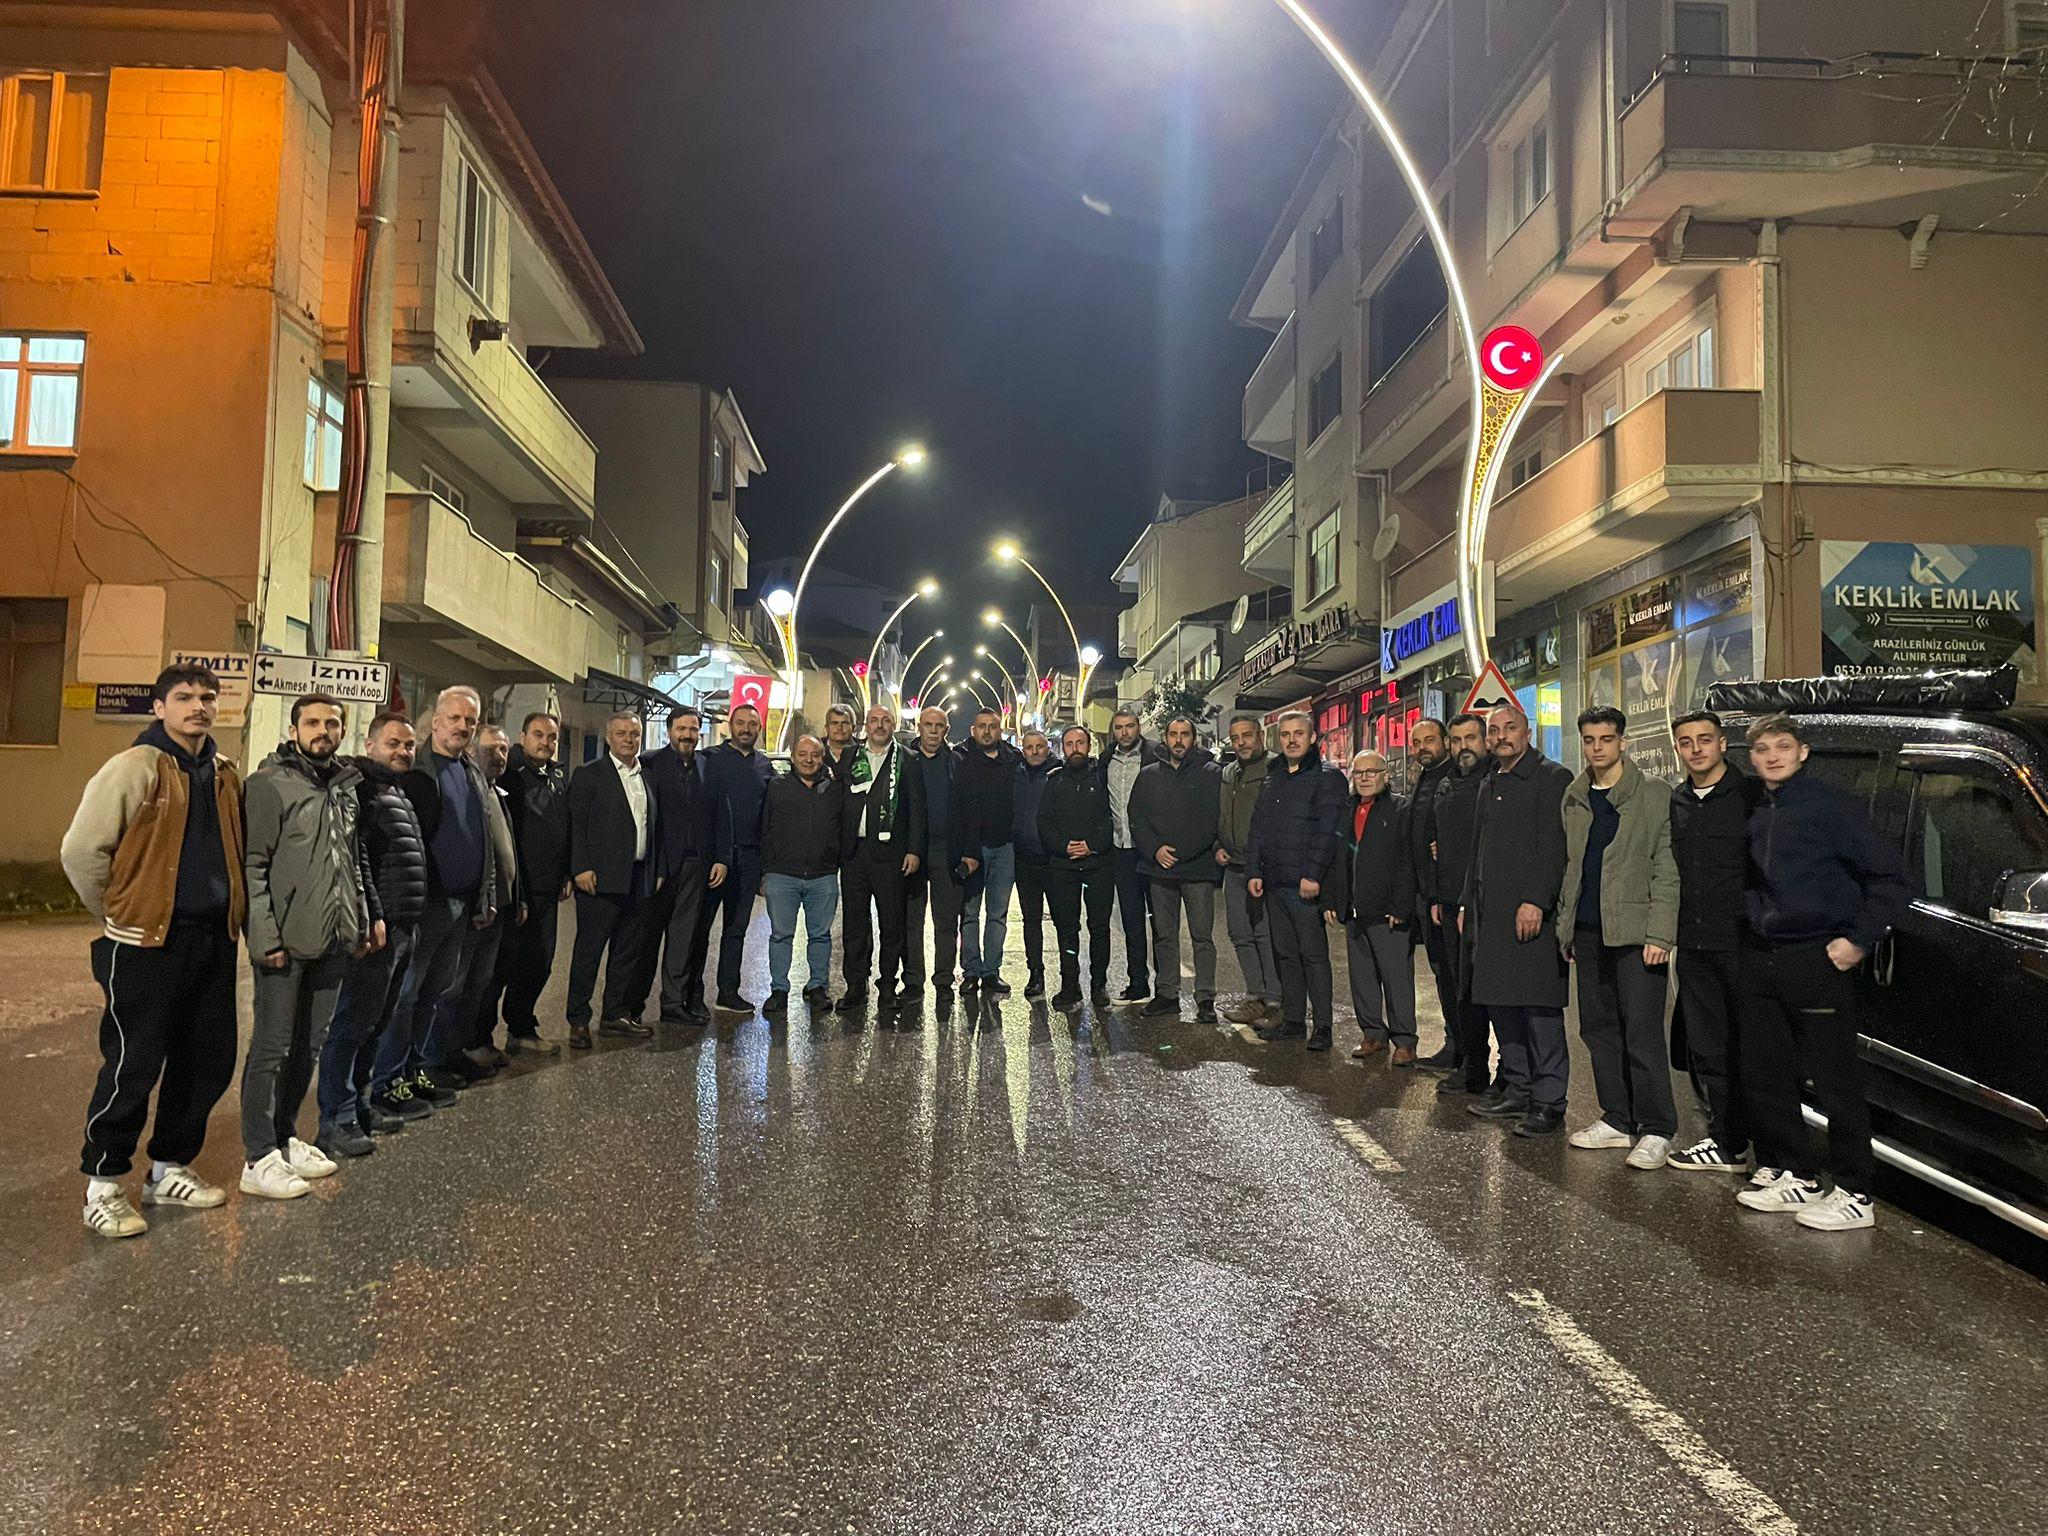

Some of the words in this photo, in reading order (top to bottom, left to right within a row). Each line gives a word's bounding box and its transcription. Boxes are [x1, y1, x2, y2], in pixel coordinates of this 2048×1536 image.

[1653, 600, 1673, 616] EMLAK
[1931, 588, 2021, 611] EMLAK
[1434, 597, 1461, 642] EML
[1873, 639, 1941, 650] ARAZİLERİNİZ
[1944, 639, 1986, 651] GÜNLÜK
[1893, 652, 1927, 662] ALINIR
[1929, 652, 1967, 663] SATILIR
[310, 680, 334, 694] Tarım
[337, 683, 359, 696] Kredi
[361, 685, 384, 699] Koop.
